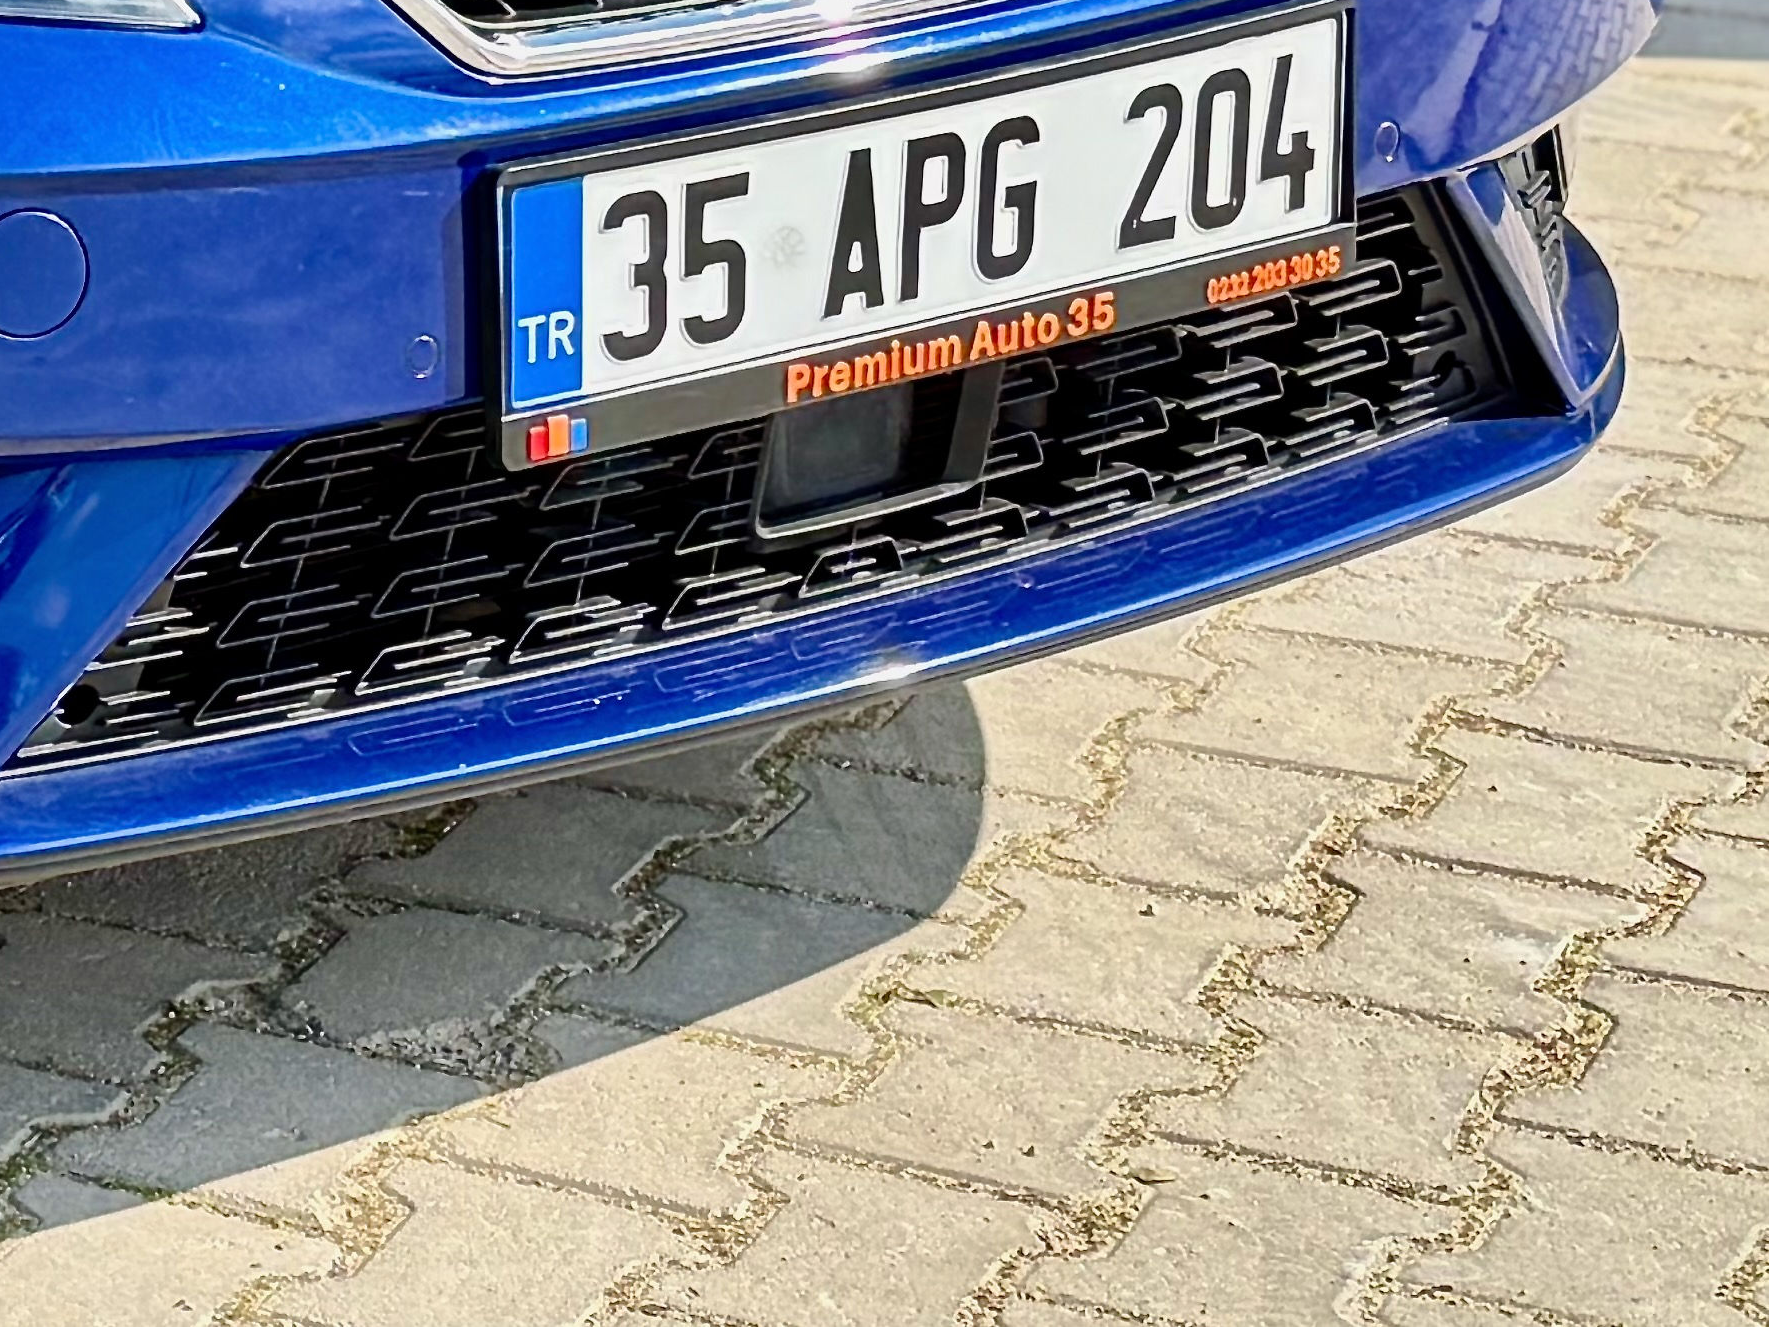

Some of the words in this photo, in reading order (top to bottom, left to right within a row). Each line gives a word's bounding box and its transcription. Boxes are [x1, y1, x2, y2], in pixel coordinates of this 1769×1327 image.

[602, 172, 749, 361] 35
[823, 116, 1040, 319] APG
[1119, 54, 1314, 249] 204
[1251, 259, 1287, 293] 203
[1289, 253, 1313, 284] 30
[1315, 246, 1341, 277] 35
[518, 311, 575, 363] TR
[787, 334, 961, 403] Premium
[969, 311, 1060, 361] Auto
[1066, 291, 1115, 338] 35
